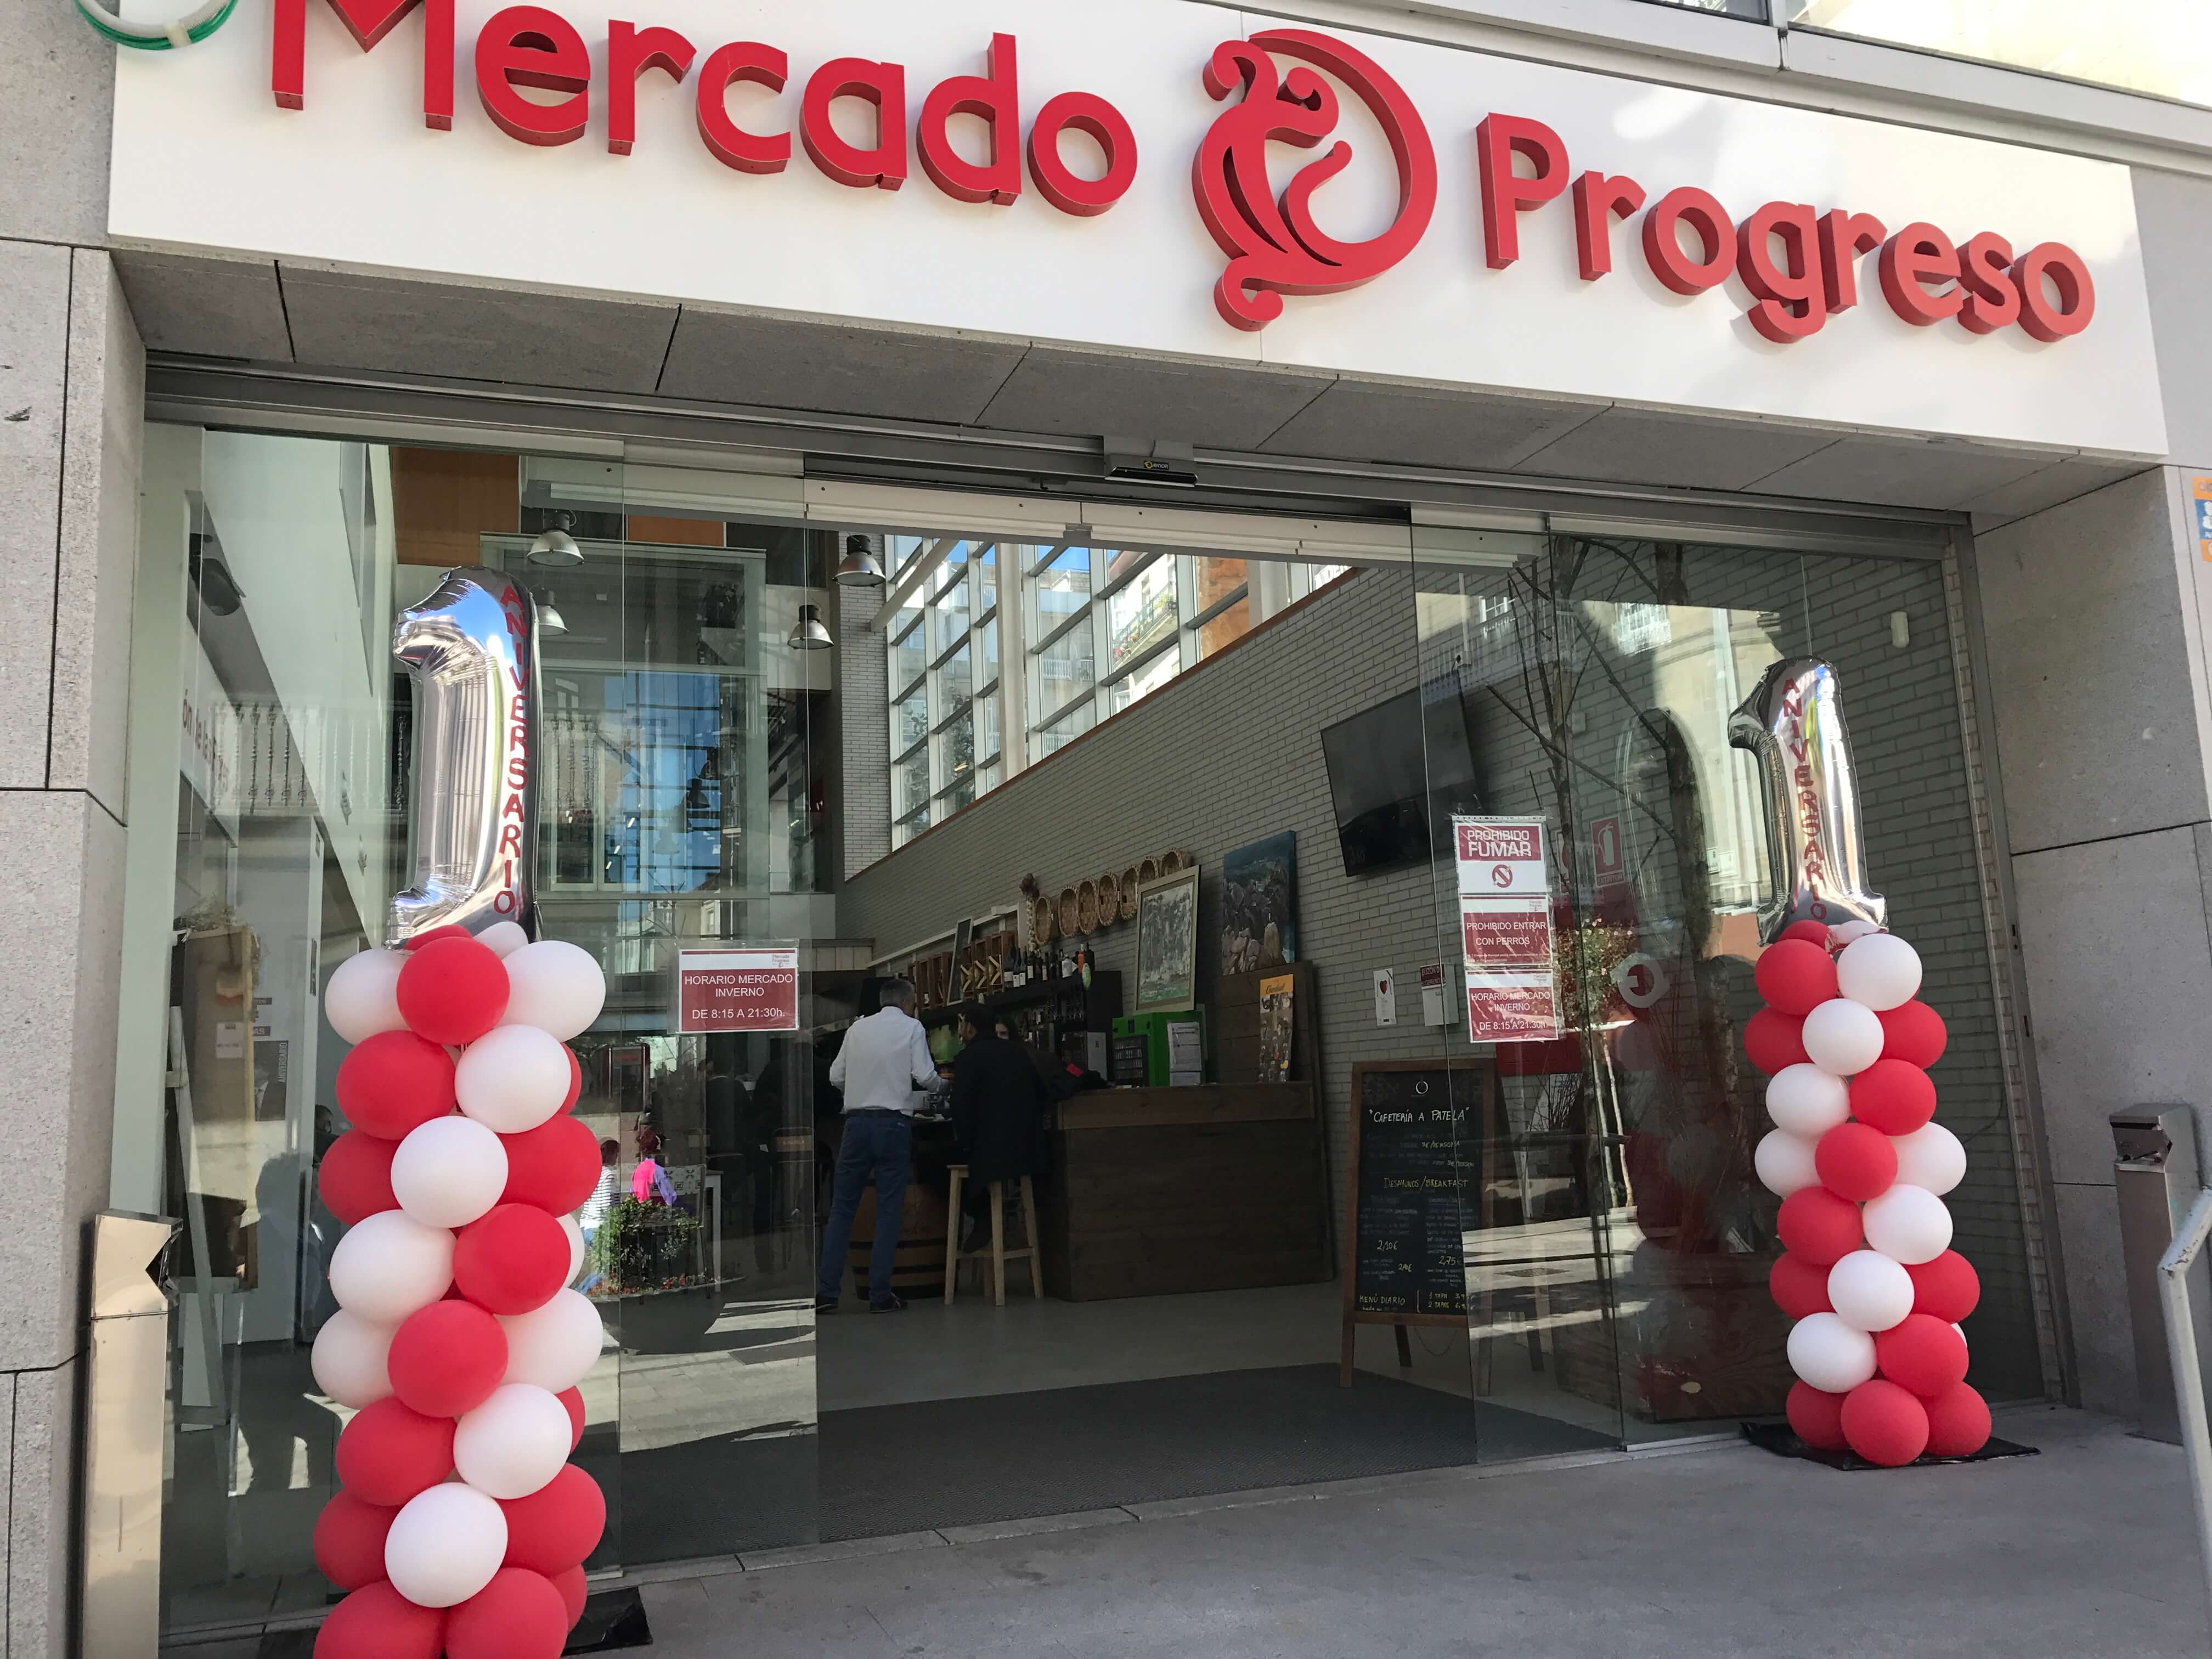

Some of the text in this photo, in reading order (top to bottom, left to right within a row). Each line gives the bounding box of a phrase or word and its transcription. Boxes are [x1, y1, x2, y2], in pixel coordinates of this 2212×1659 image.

[272, 0, 2095, 344] Mercado Progreso
[494, 584, 529, 915] ANIVERSARIO
[1782, 678, 1826, 920] ANIVERSARIO
[1467, 830, 1530, 842] PROHIBIDO
[1468, 842, 1532, 857] FUMAR
[1466, 922, 1546, 930] PROHIBIDO ENTRAR
[1476, 937, 1530, 945] CON PERROS
[685, 974, 793, 985] HORARIO MERCADO
[715, 987, 764, 997] INVERNO
[1471, 992, 1508, 1001] HORARIO
[1494, 1003, 1531, 1011] INVERNO
[692, 1008, 785, 1019] DE 8:15 A 21:30h.
[1480, 1022, 1492, 1030] DE
[1493, 1021, 1510, 1030] 8:15
[1512, 1021, 1519, 1029] A
[1418, 1113, 1425, 1121] A
[1380, 1295, 1406, 1306] DIARIO
